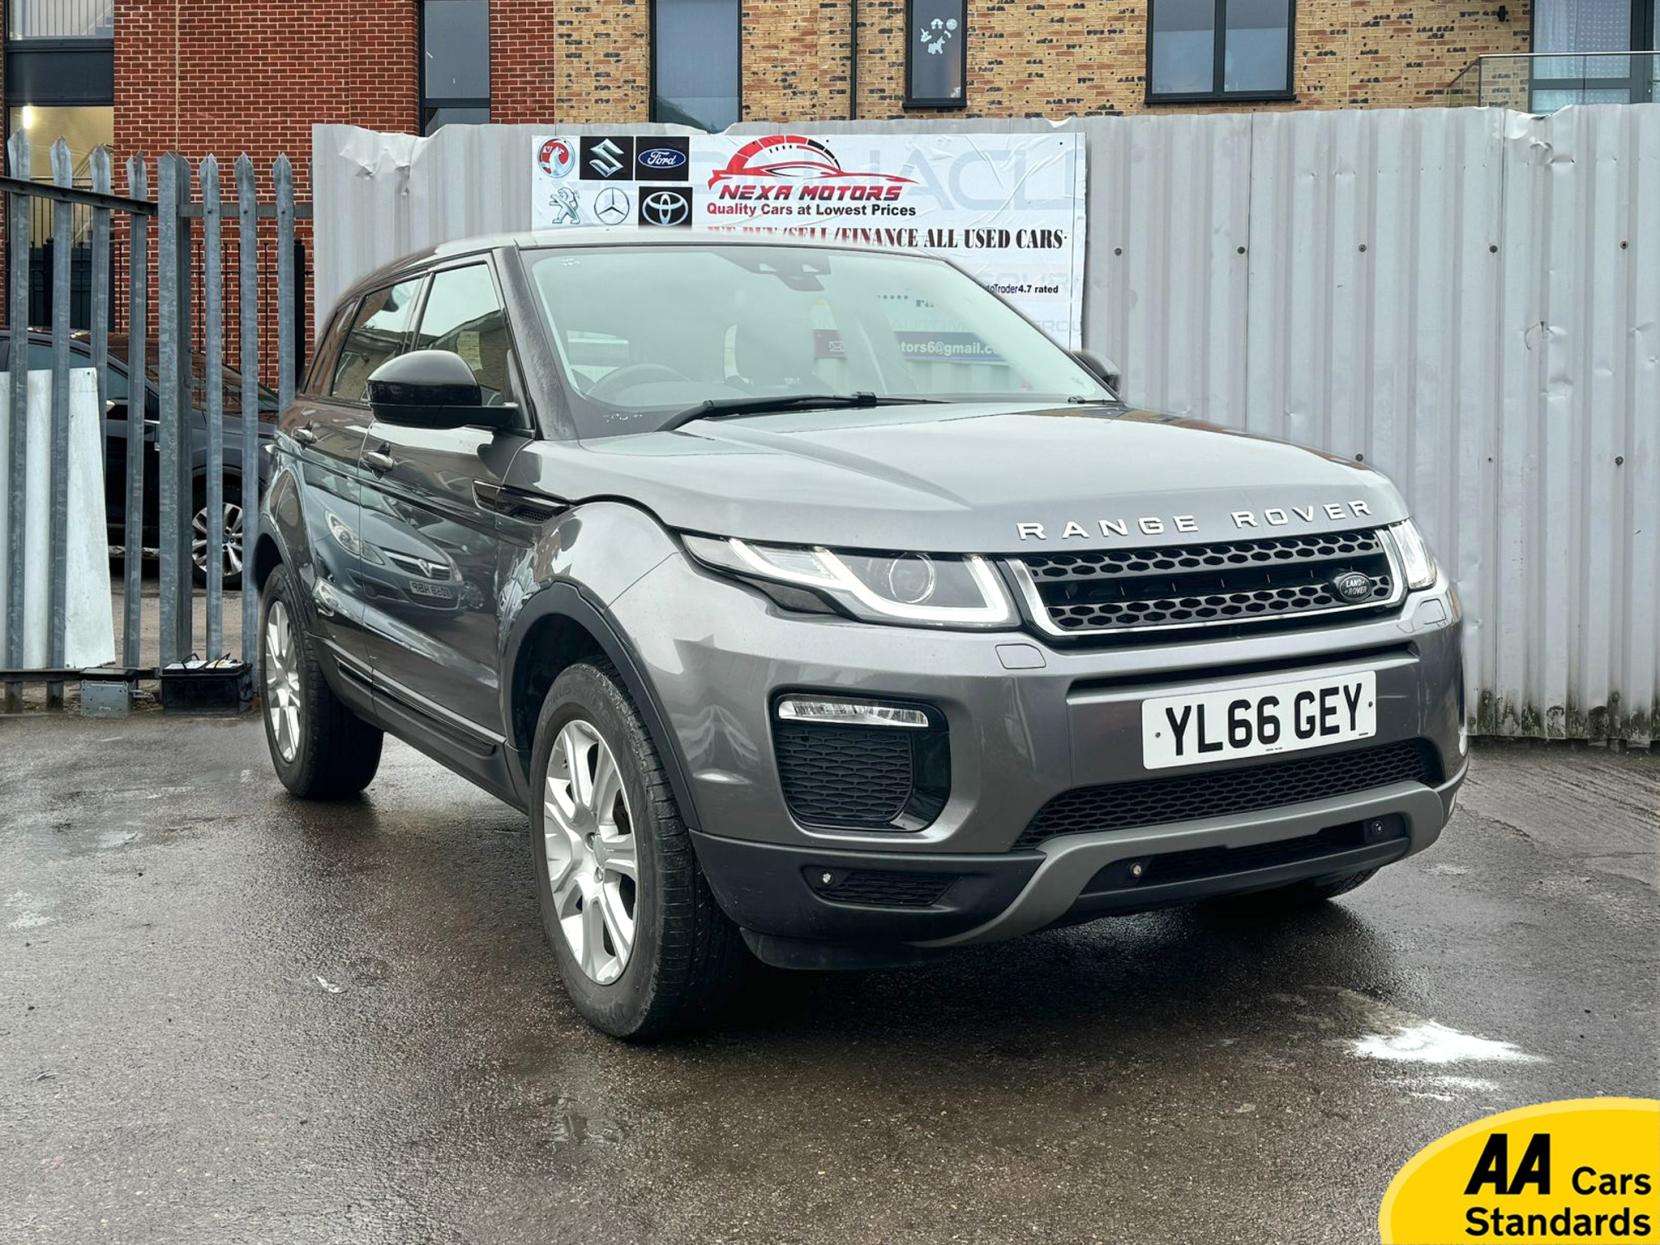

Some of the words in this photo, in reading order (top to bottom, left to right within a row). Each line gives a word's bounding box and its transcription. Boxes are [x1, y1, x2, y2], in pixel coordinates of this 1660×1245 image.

[647, 151, 677, 165] Ford
[718, 184, 794, 201] NEXA
[798, 185, 903, 202] MOTORS
[706, 202, 757, 218] Quality
[760, 203, 793, 215] Cars
[797, 204, 812, 215] at
[815, 203, 868, 216] Lowest
[871, 204, 917, 217] Prices
[923, 228, 958, 249] ALL
[963, 228, 1011, 249] USED
[1015, 228, 1063, 250] CARS
[1034, 284, 1059, 294] rated
[1015, 514, 1200, 541] RANGE
[1230, 499, 1374, 528] ROVER
[1164, 695, 1281, 757] YL66
[1293, 682, 1363, 741] GEY
